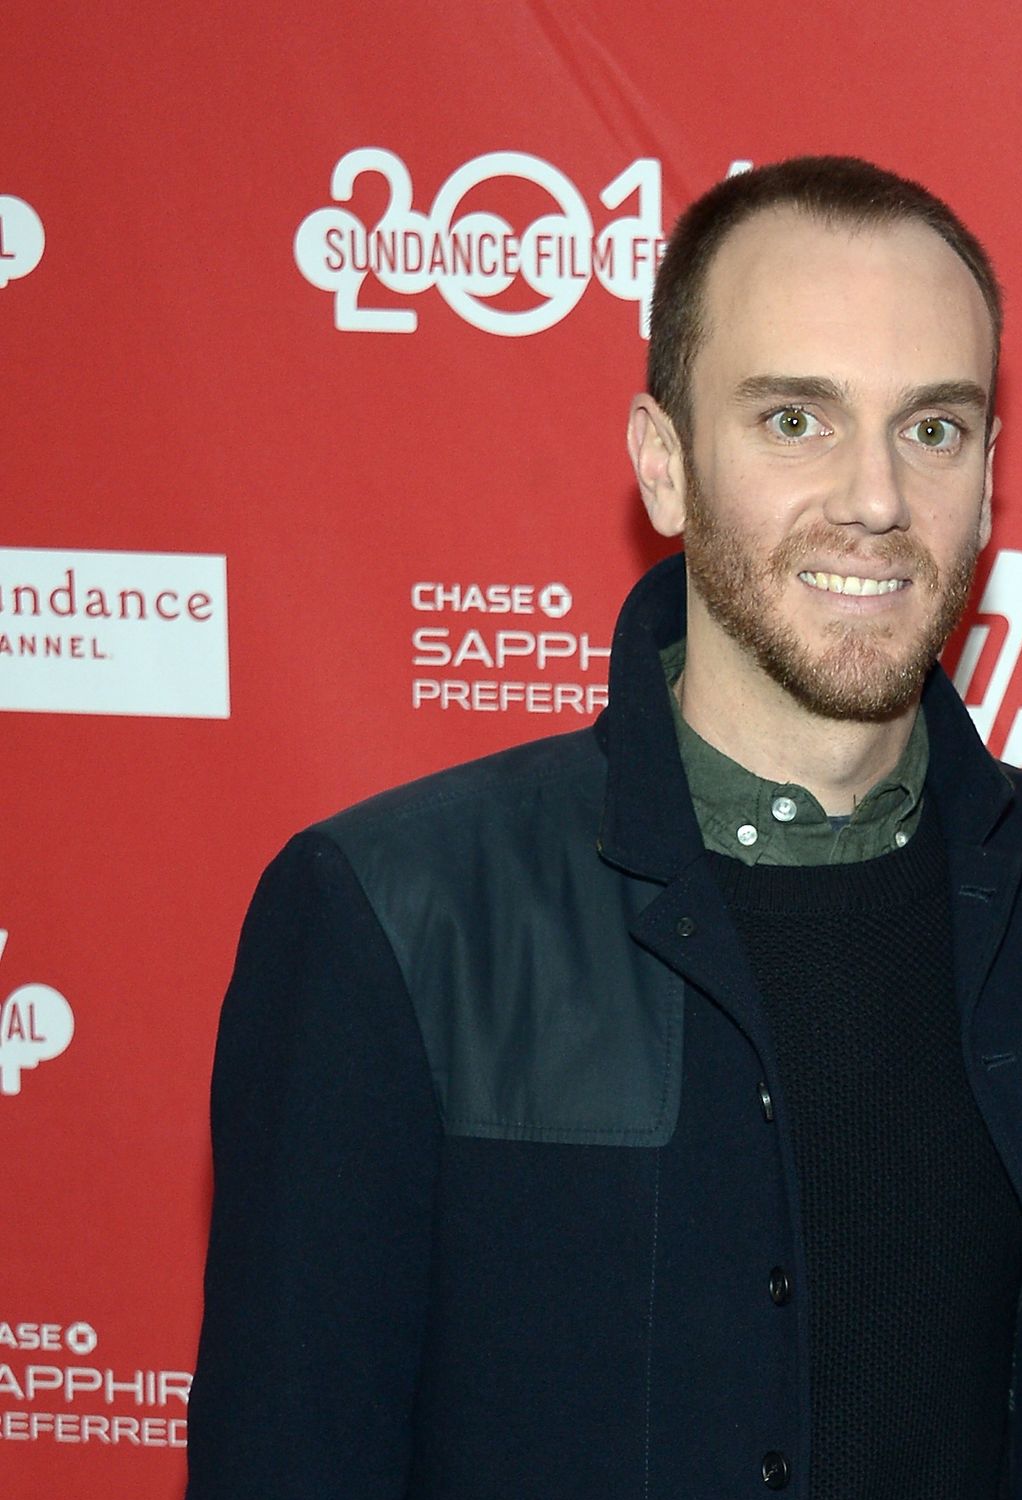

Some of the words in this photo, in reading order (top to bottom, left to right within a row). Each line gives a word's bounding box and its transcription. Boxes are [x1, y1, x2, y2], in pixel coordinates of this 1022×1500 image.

[325, 227, 519, 276] SUNDANCE
[535, 233, 615, 280] FILM
[328, 146, 754, 341] 201
[0, 568, 212, 622] ndance
[411, 582, 536, 614] CHASE
[0, 1411, 188, 1448] EFERRED
